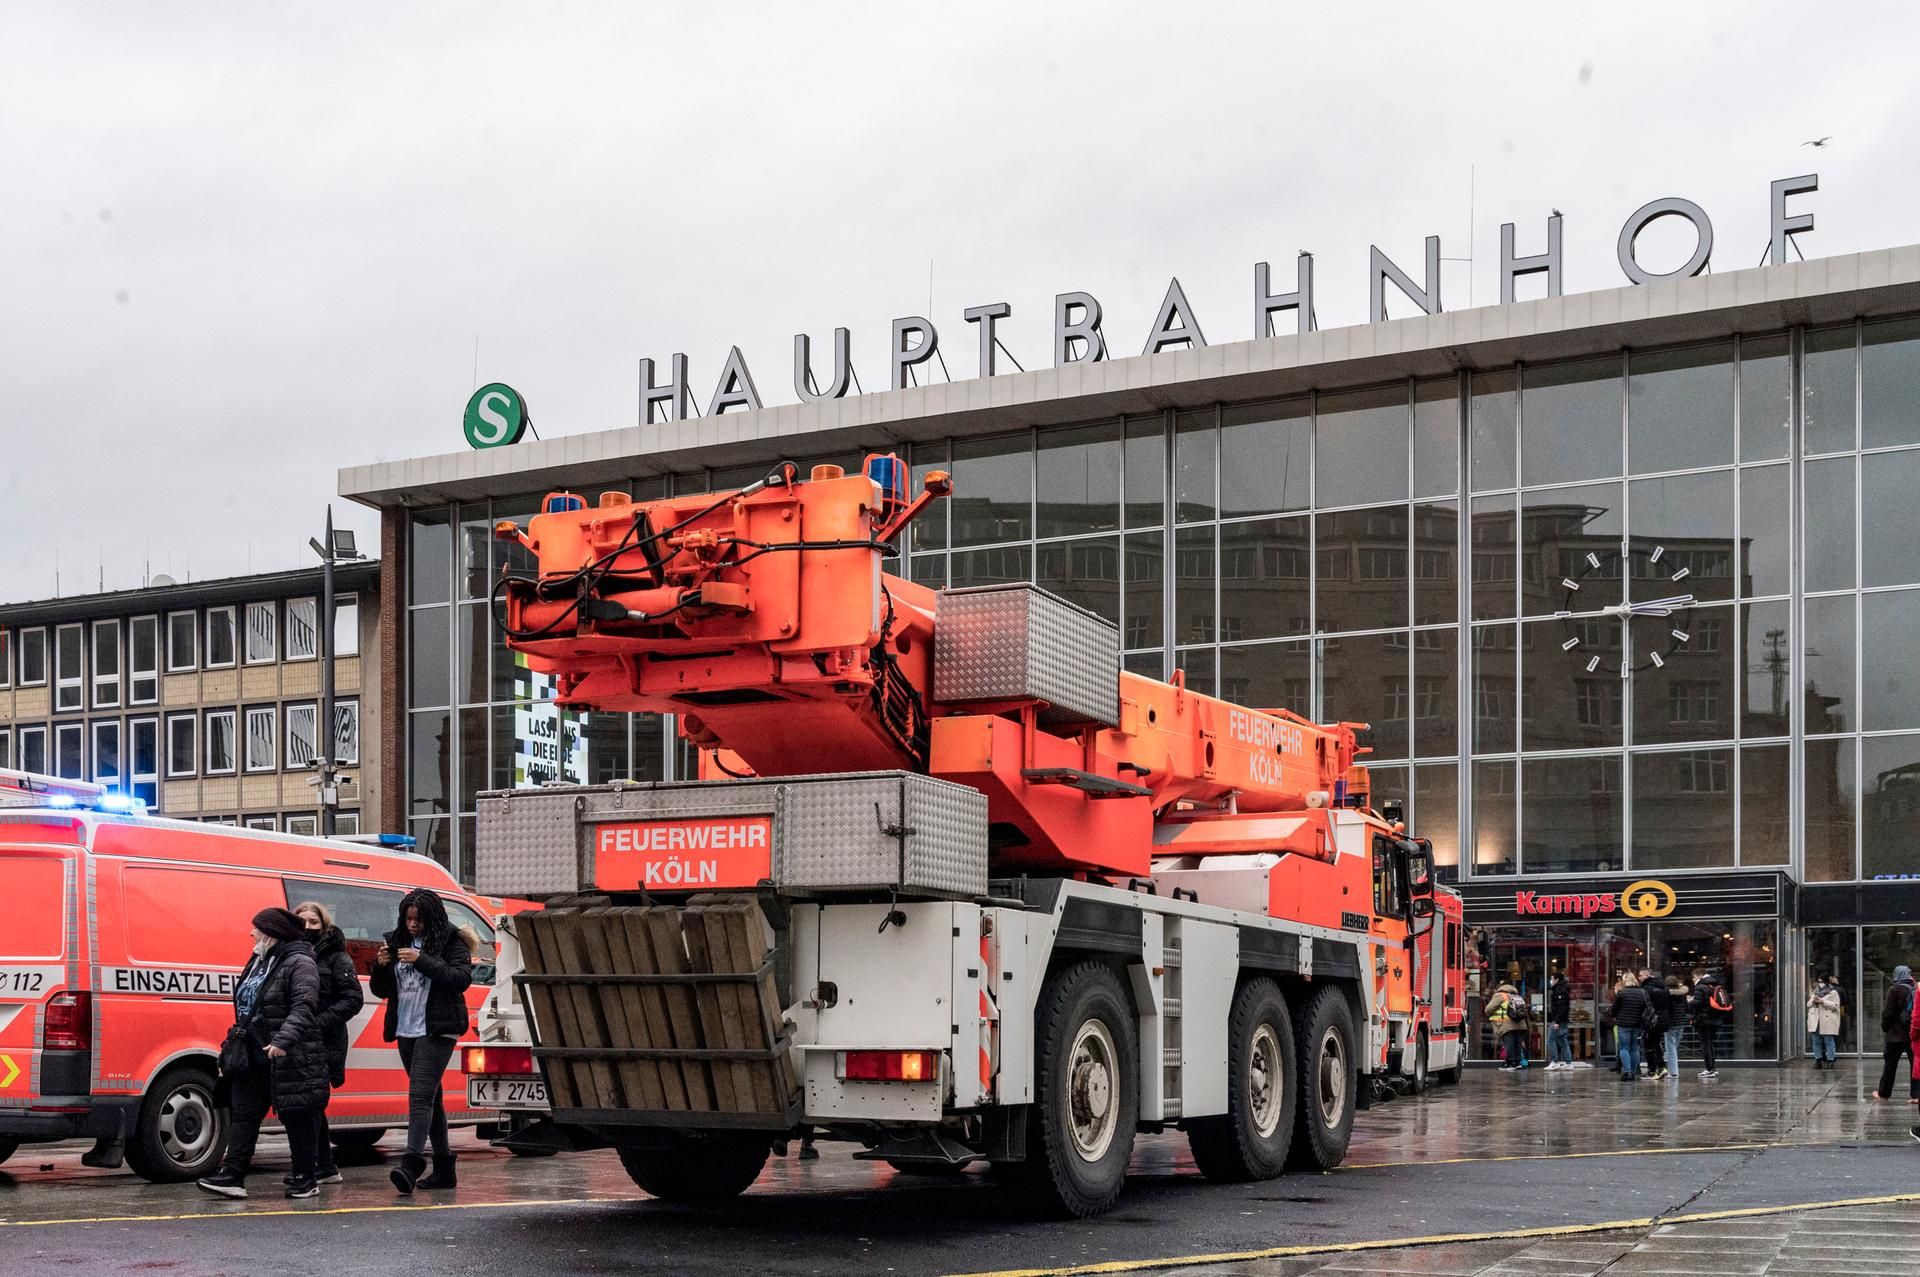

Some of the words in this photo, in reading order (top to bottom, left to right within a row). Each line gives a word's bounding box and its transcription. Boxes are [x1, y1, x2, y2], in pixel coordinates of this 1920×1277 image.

[639, 173, 1819, 425] HAUPTBAHNHOF
[473, 391, 511, 444] S
[1229, 709, 1303, 757] FEUERWEHR
[532, 741, 548, 760] DIE
[1249, 748, 1283, 787] KÖLN
[601, 825, 766, 852] FEUERWEHR
[645, 856, 717, 884] KÖLN
[1516, 890, 1616, 918] Kamps
[1342, 911, 1369, 931] LIEBHERR
[13, 972, 43, 991] 112
[477, 1082, 487, 1100] K
[508, 1083, 547, 1101] 2745
